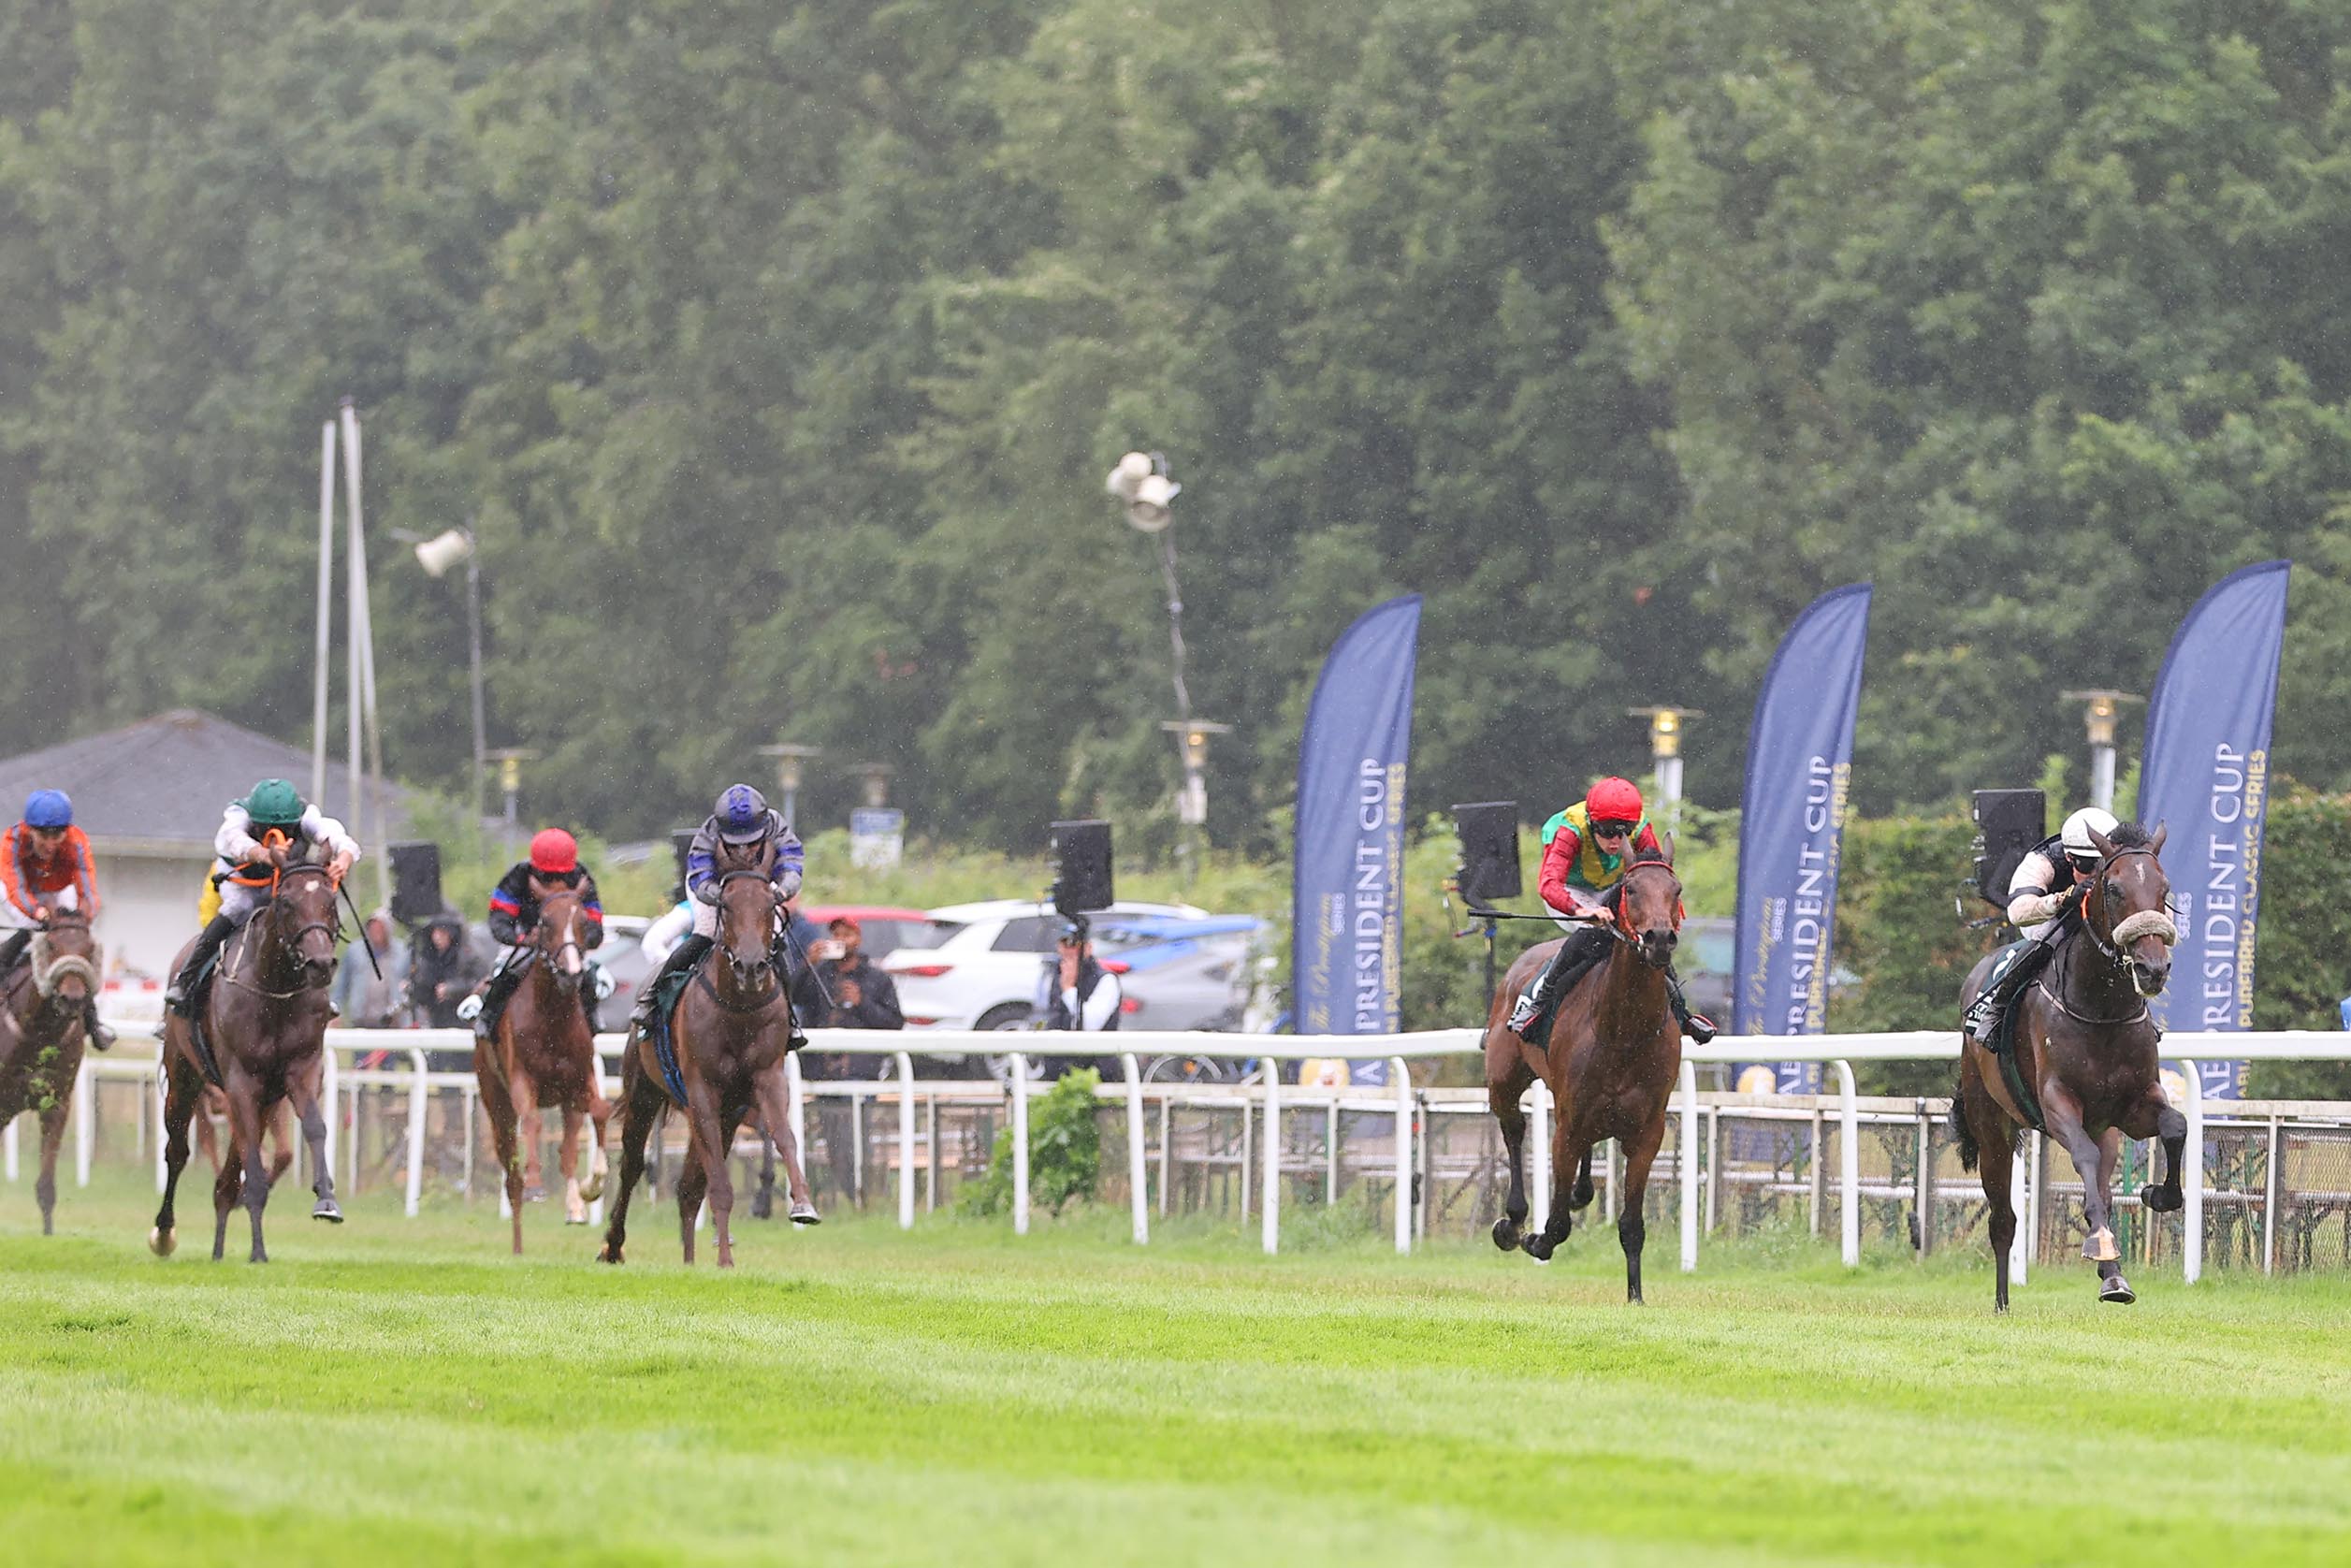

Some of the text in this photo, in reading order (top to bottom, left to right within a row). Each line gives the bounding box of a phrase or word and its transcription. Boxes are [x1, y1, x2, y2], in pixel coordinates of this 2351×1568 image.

[1359, 758, 1386, 831] CUP
[1805, 756, 1832, 833] CUP
[2211, 742, 2244, 823] CUP
[1355, 838, 1385, 1030] PRESIDENT
[2177, 892, 2193, 939] SERIES
[2203, 835, 2237, 1032] RESIDENT
